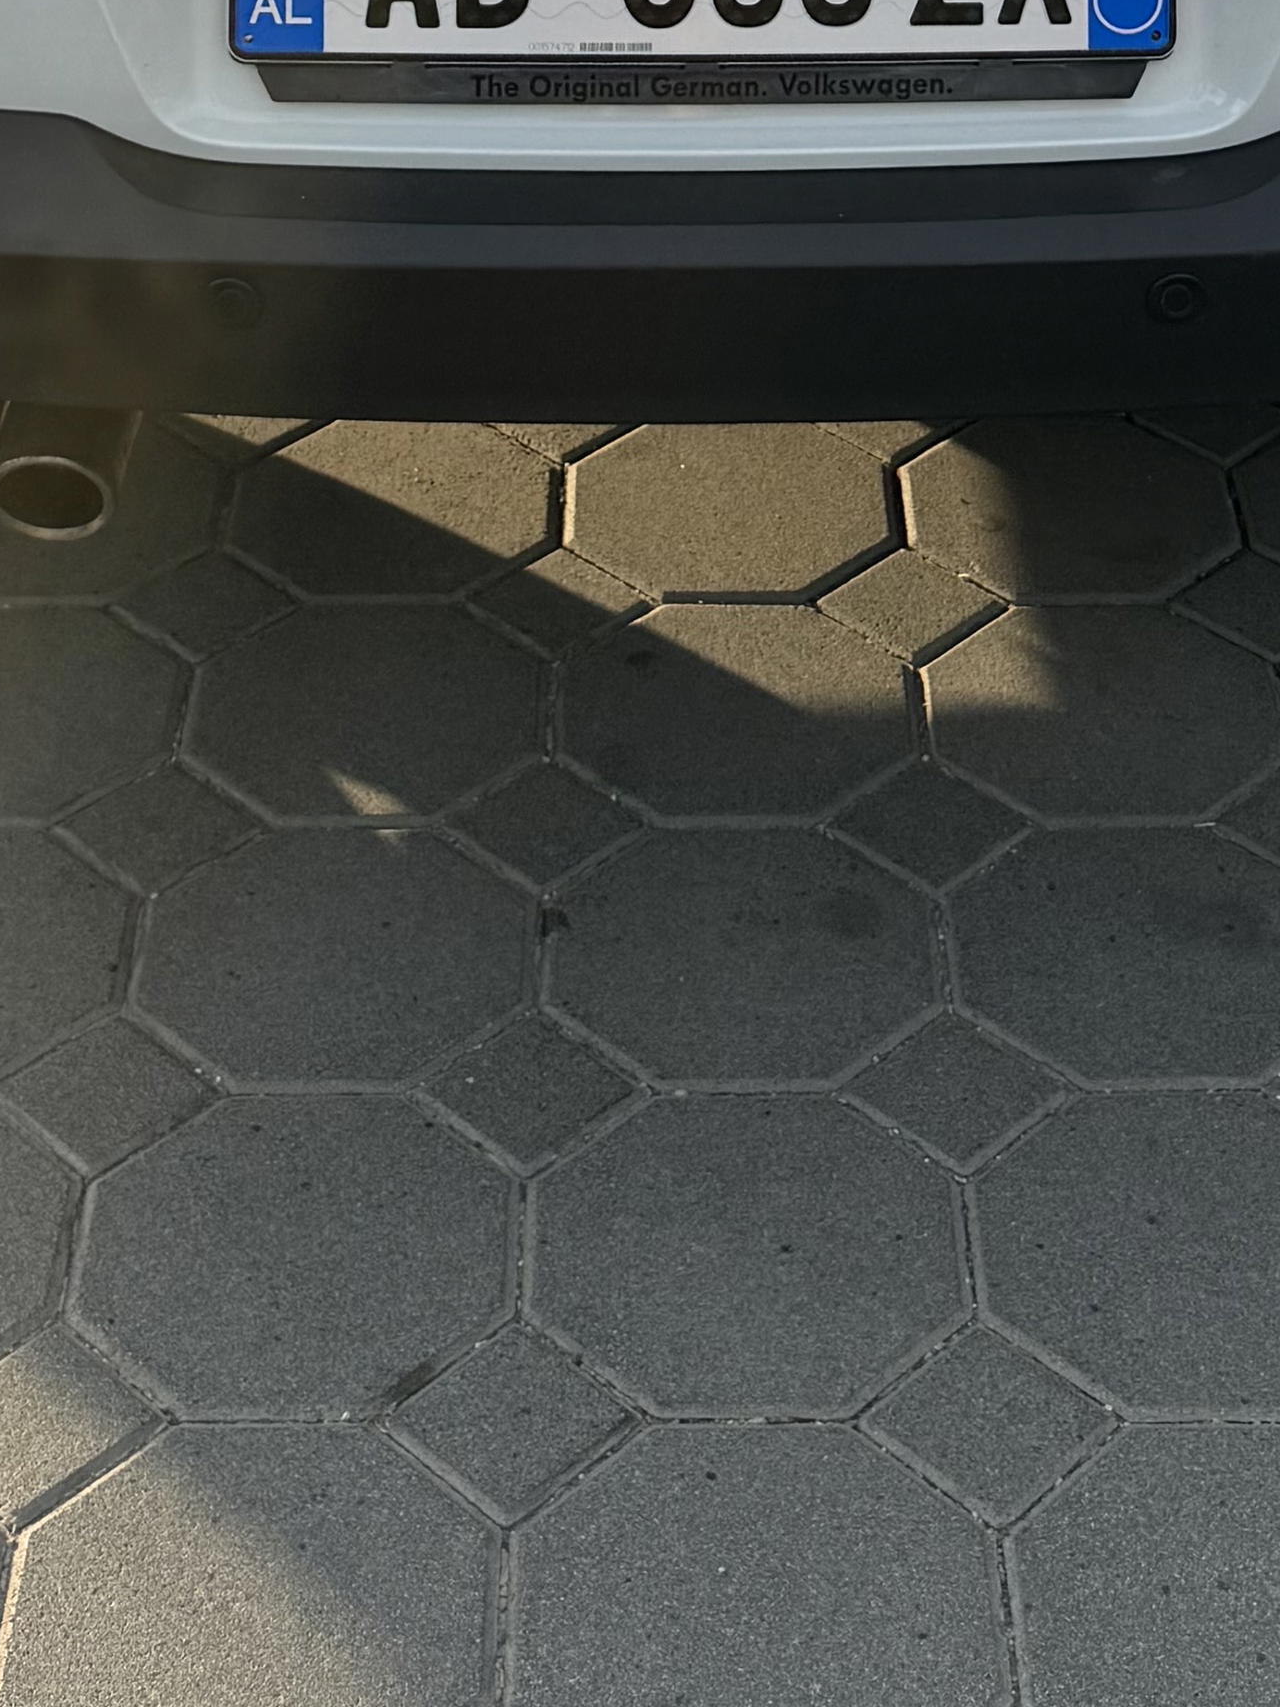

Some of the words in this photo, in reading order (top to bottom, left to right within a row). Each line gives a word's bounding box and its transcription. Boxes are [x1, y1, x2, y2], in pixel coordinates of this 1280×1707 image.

[471, 73, 519, 98] The
[529, 74, 639, 103] Original
[651, 74, 767, 98] German.
[778, 72, 953, 100] Volkswagen.
